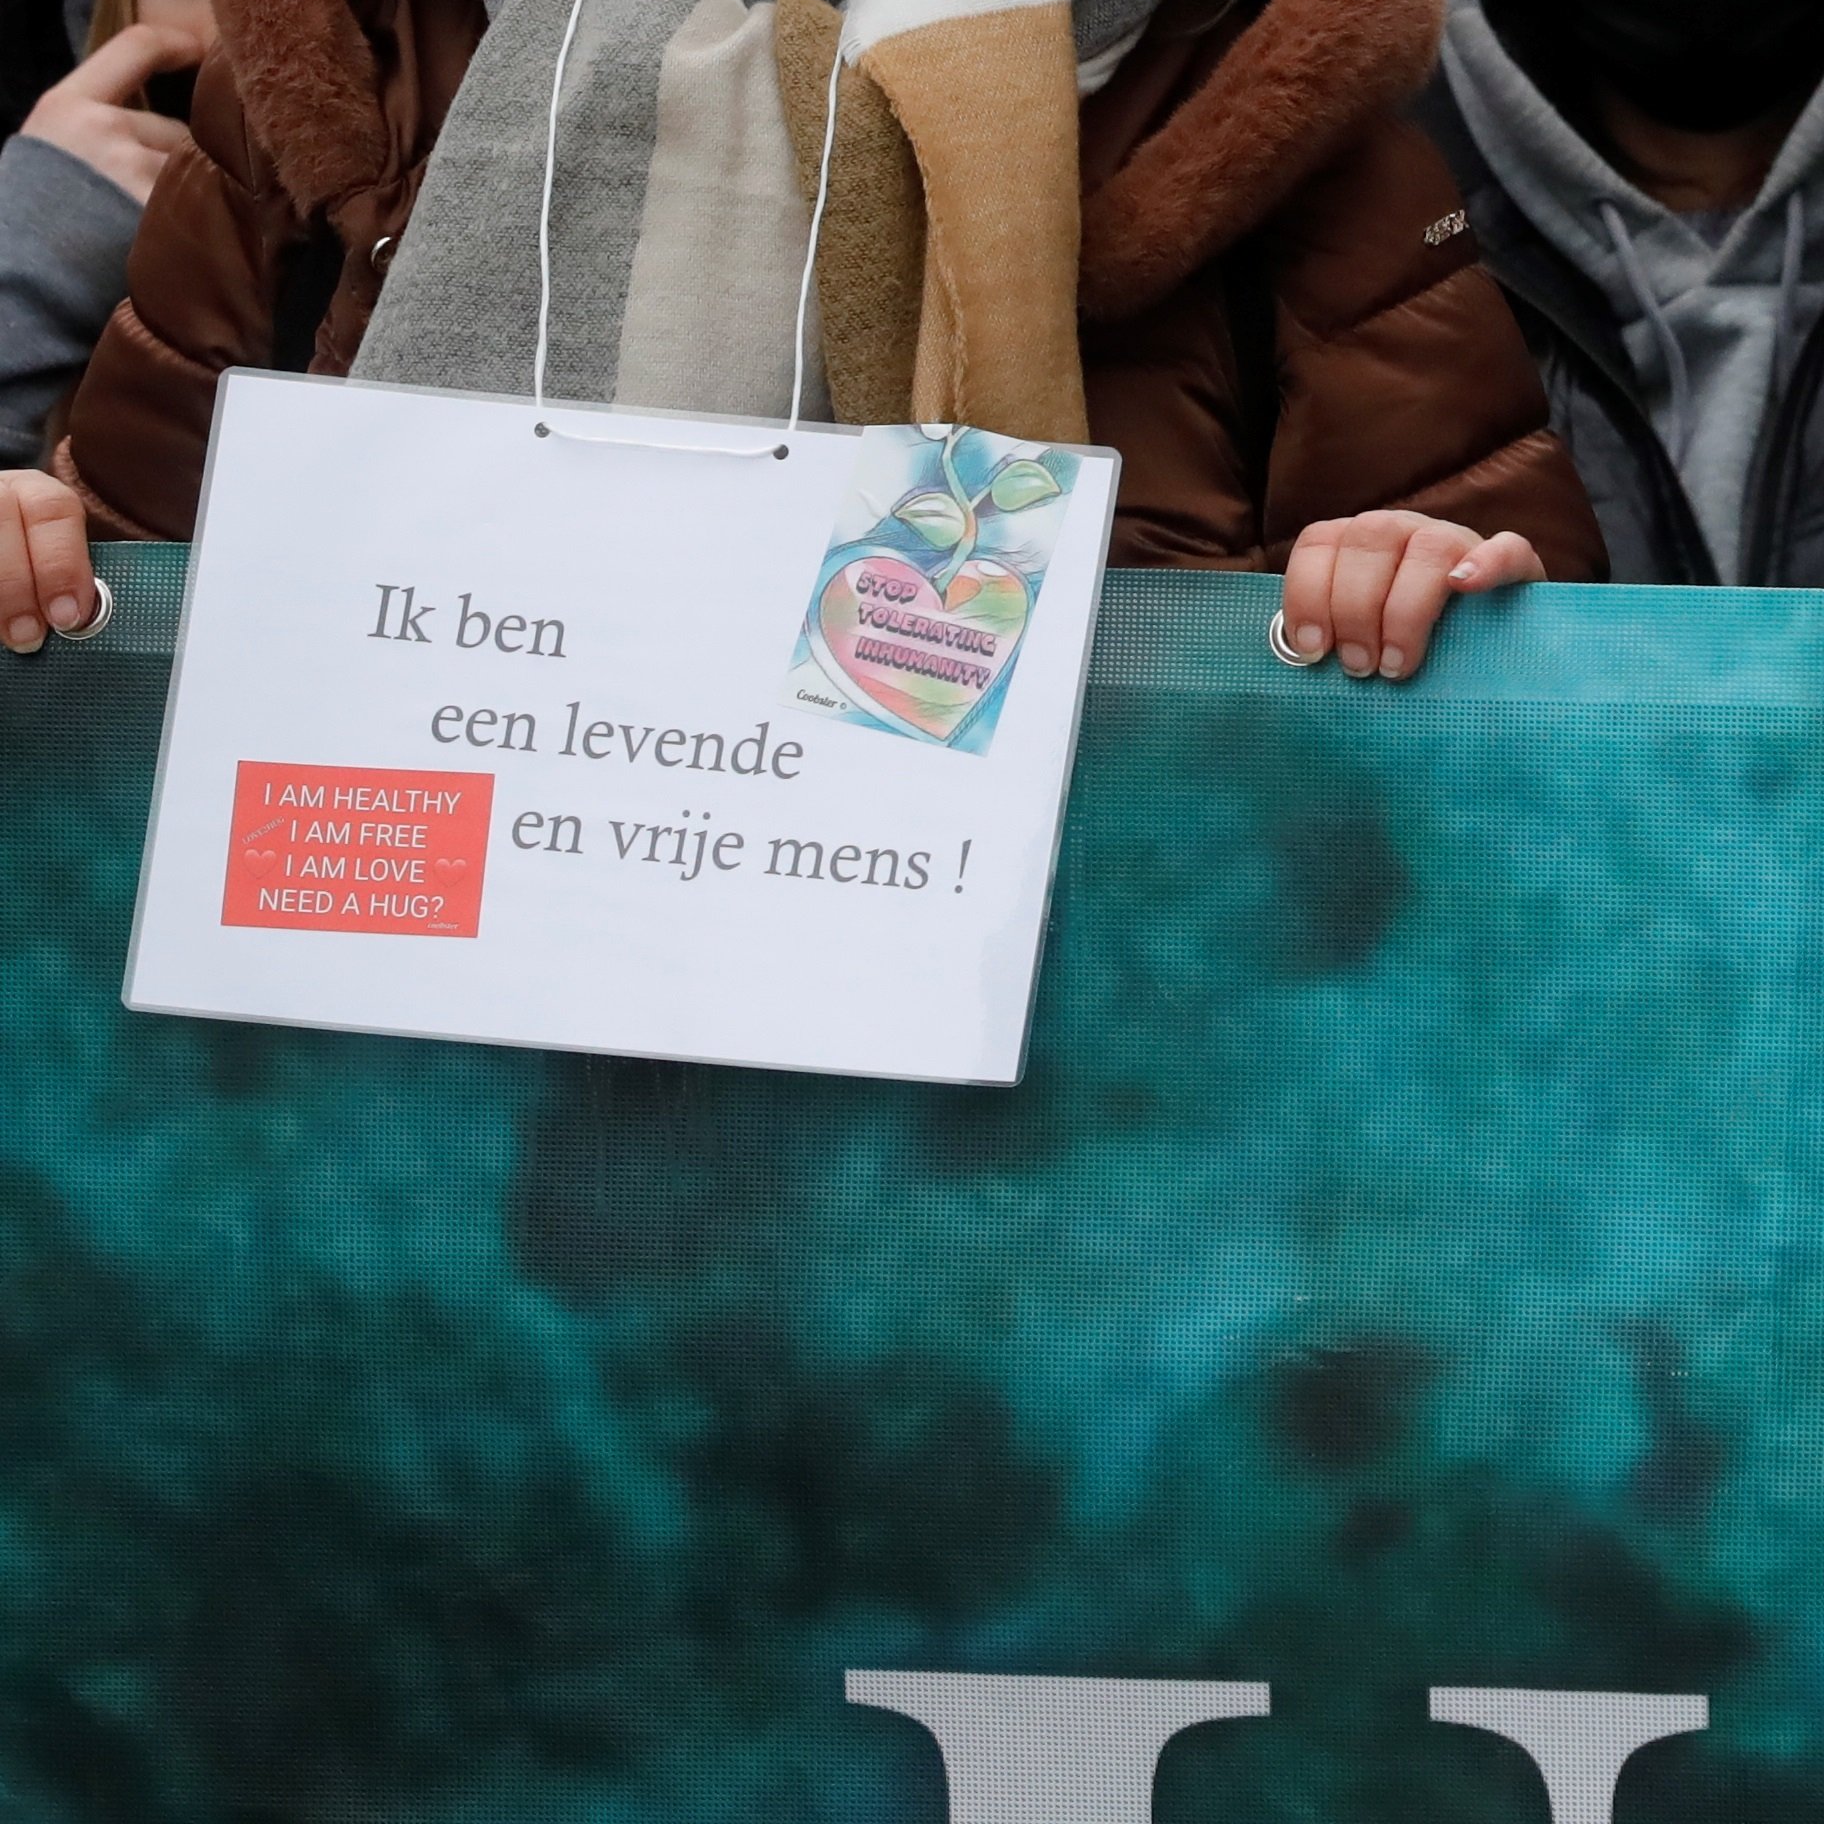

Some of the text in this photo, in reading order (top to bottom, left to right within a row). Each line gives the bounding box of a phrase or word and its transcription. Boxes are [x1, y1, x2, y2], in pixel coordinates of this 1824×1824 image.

[857, 571, 918, 603] STOP
[366, 583, 567, 659] Ik ben
[859, 604, 998, 656] TOLERATING
[855, 638, 991, 689] INHUMANITY
[431, 701, 804, 781] een levende
[264, 782, 462, 815] I AM HEALTHY
[290, 819, 428, 849] I AM FREE
[511, 811, 584, 855] en
[608, 809, 745, 882] vrije
[763, 838, 931, 890] mens
[286, 854, 426, 883] I AM LOVE
[259, 887, 444, 919] NEED A HUG?
